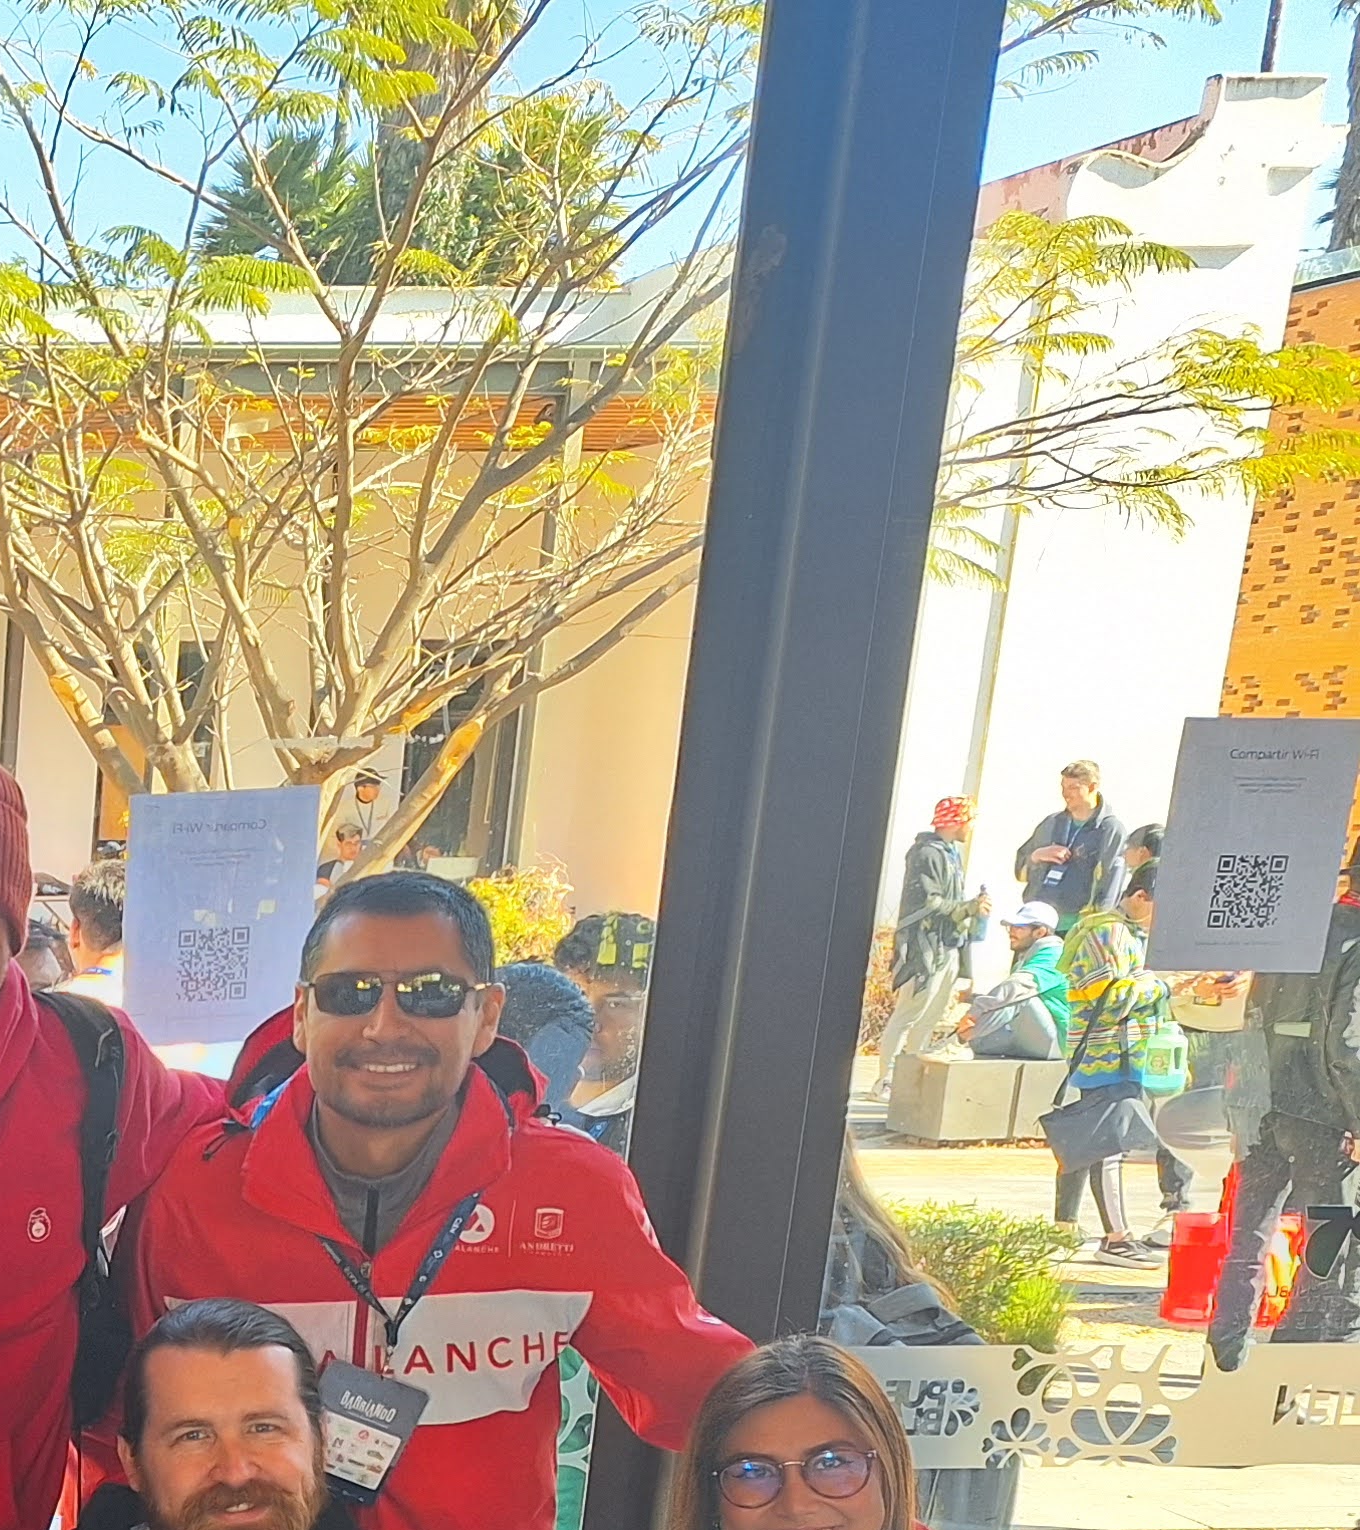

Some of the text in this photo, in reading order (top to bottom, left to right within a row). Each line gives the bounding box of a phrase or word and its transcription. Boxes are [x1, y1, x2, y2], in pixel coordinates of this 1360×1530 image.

[1230, 748, 1320, 760] Compartir Wi-Fi
[454, 1245, 499, 1253] ALANCHE
